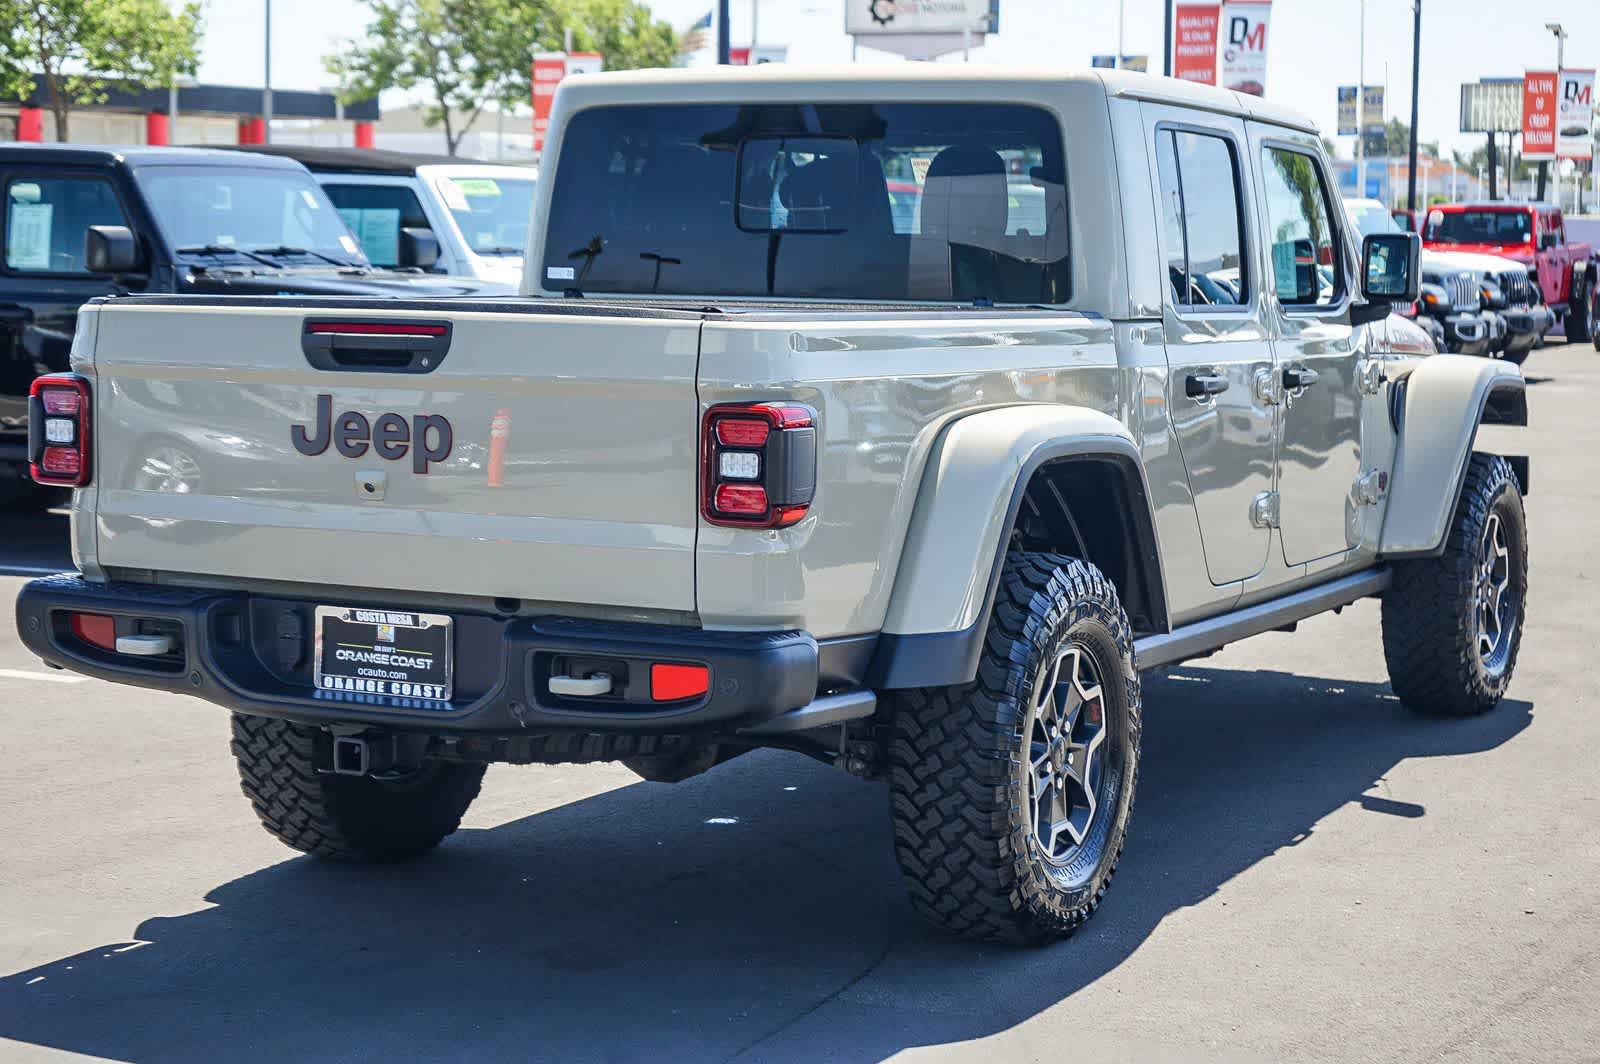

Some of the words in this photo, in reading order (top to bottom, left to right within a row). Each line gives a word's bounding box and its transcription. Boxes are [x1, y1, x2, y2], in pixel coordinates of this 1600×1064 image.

[291, 394, 453, 474] Jeep
[355, 610, 387, 624] COSTA
[388, 613, 414, 626] MESA
[335, 649, 390, 665] ORANGE
[390, 653, 434, 670] COAST
[357, 667, 408, 680] ocauto.com
[323, 676, 385, 693] ORANGE
[391, 684, 443, 698] COAST
